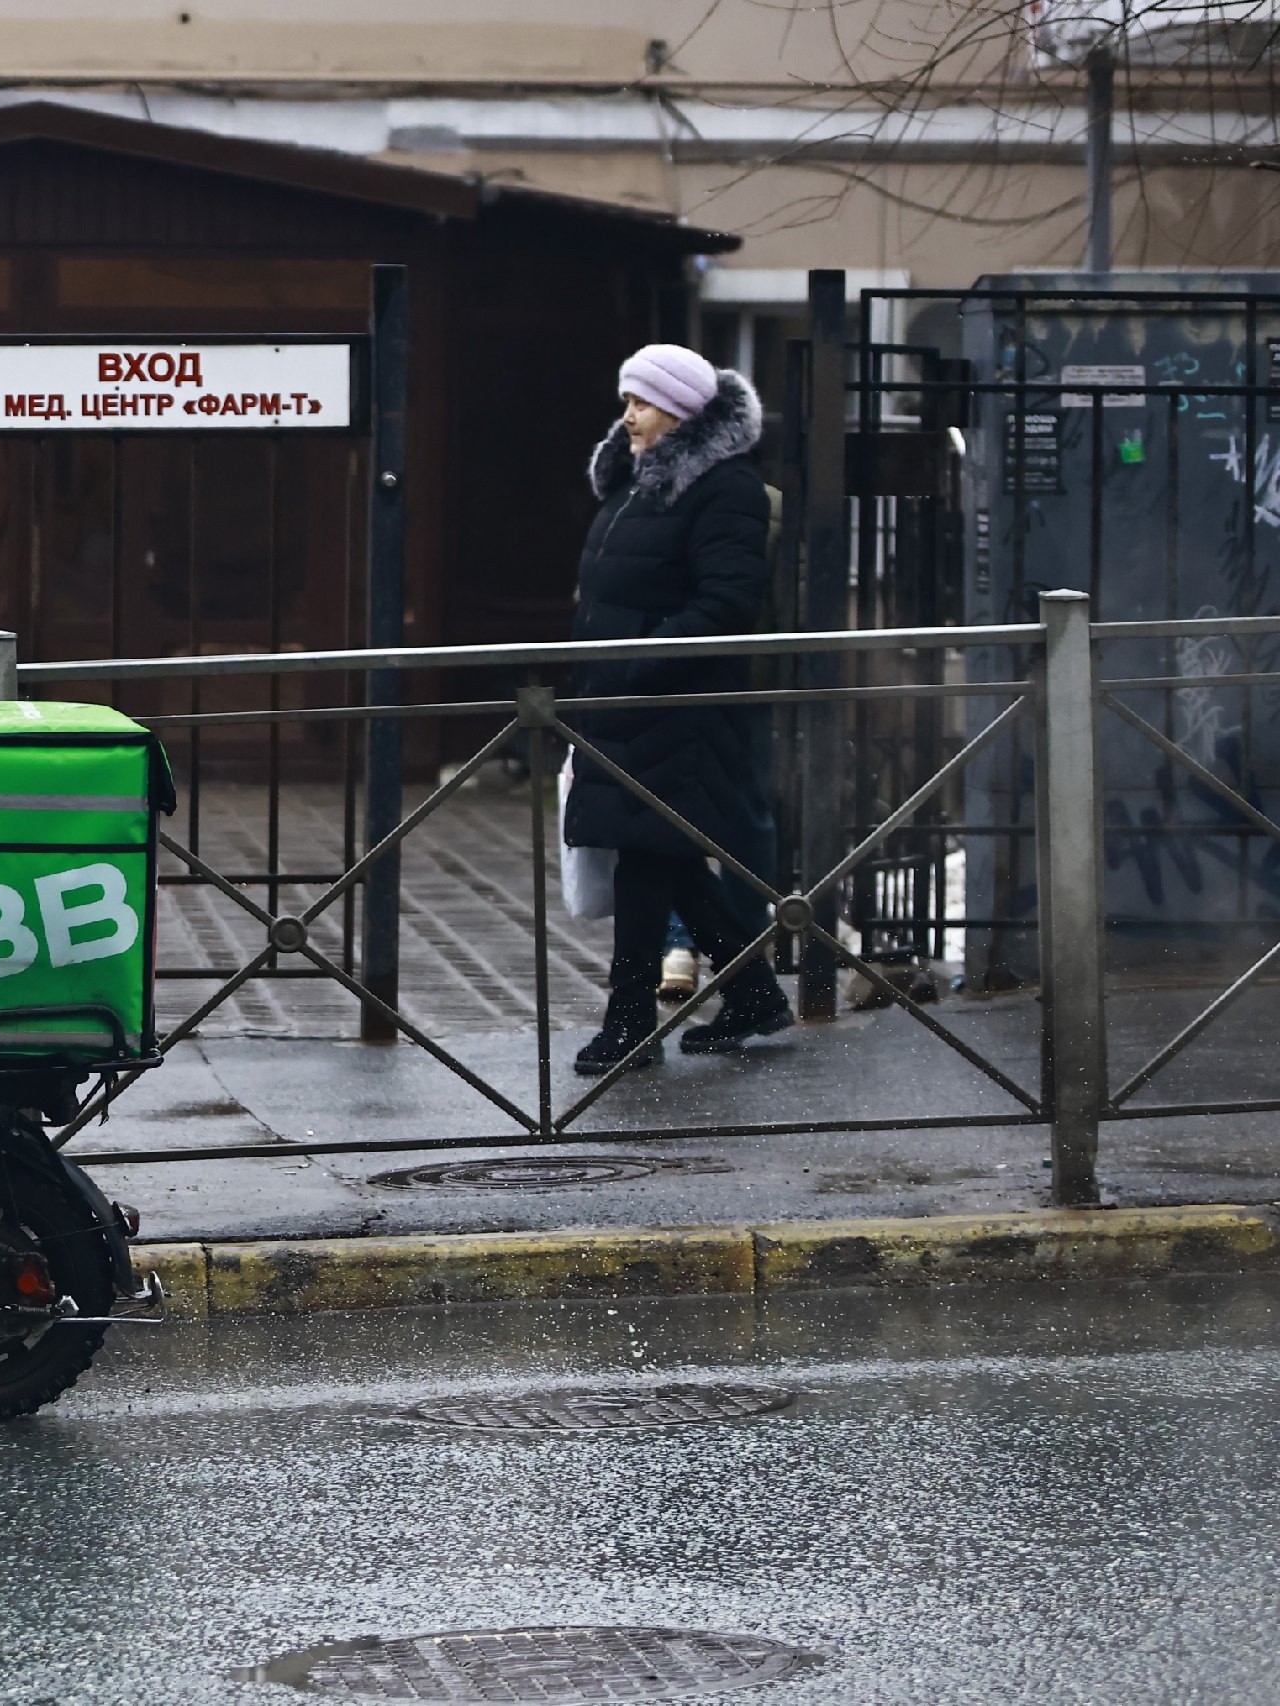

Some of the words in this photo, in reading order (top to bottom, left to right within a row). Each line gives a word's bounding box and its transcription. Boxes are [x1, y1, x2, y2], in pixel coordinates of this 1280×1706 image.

[98, 352, 203, 388] ВХОД
[5, 394, 72, 421] МЕД.
[81, 393, 174, 421] ЦЕНТР
[182, 392, 323, 417] «ФАРМ-Т»
